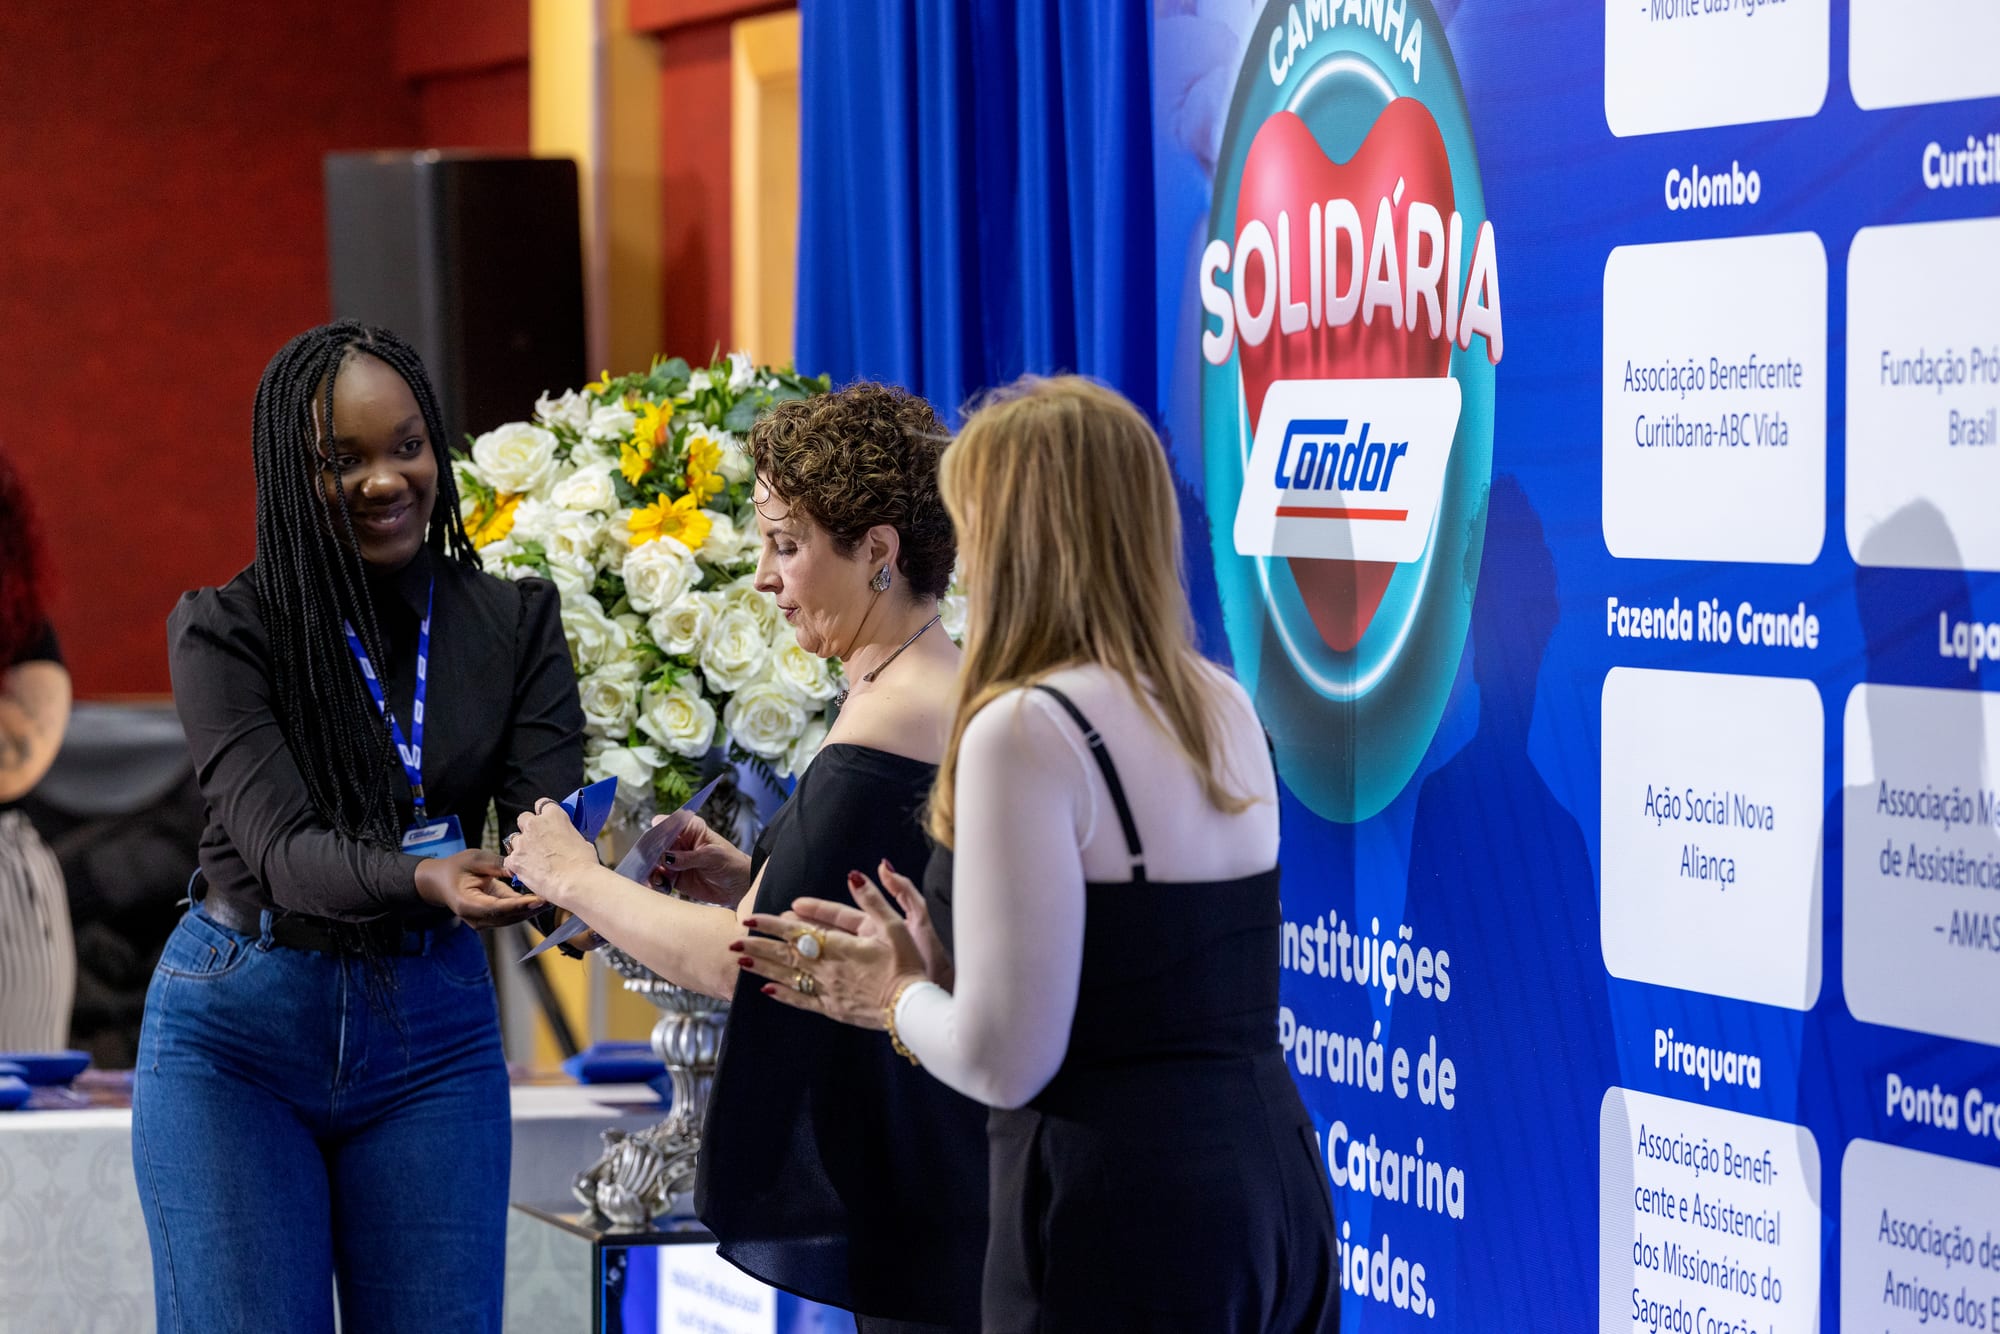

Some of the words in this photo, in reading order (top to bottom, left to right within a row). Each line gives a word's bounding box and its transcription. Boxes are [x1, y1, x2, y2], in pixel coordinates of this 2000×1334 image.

[1664, 160, 1761, 211] Colombo
[1201, 176, 1504, 366] SOLIDÁRIA
[1624, 359, 1705, 400] Associação
[1710, 353, 1803, 391] Beneficente
[1880, 347, 1967, 396] Fundação
[1275, 418, 1408, 492] Condor
[1635, 412, 1750, 449] Curitibana-ABC
[1754, 411, 1789, 447] Vida
[1948, 406, 1997, 446] Brasil
[1606, 596, 1693, 641] Fazenda
[1698, 598, 1732, 644] Rio
[1736, 601, 1819, 649] Grande
[1644, 784, 1681, 827] Ação
[1685, 788, 1729, 827] Social
[1734, 793, 1774, 831] Nova
[1877, 779, 1974, 832] Associação
[1680, 844, 1735, 891] Aliança
[1879, 837, 1902, 877] de
[1279, 900, 1451, 1006] nstituições
[1279, 1006, 1384, 1093] Paraná
[1391, 1047, 1410, 1099] e
[1417, 1034, 1456, 1110] de
[1654, 1028, 1761, 1091] Piraquara
[1886, 1072, 1959, 1131] Ponta
[1328, 1120, 1464, 1220] Catarina
[1638, 1123, 1719, 1177] Associação
[1723, 1142, 1778, 1186] Benefi-
[1634, 1185, 1675, 1219] cente
[1679, 1198, 1688, 1222] e
[1692, 1192, 1781, 1246] Assistencial
[1878, 1208, 1974, 1269] Associação
[1633, 1232, 1659, 1271] dos
[1663, 1240, 1757, 1298] Missionários
[1761, 1266, 1782, 1304] do
[1632, 1288, 1692, 1334] Sagrado
[1883, 1269, 1949, 1324] Amigos
[1954, 1285, 1986, 1330] dos
